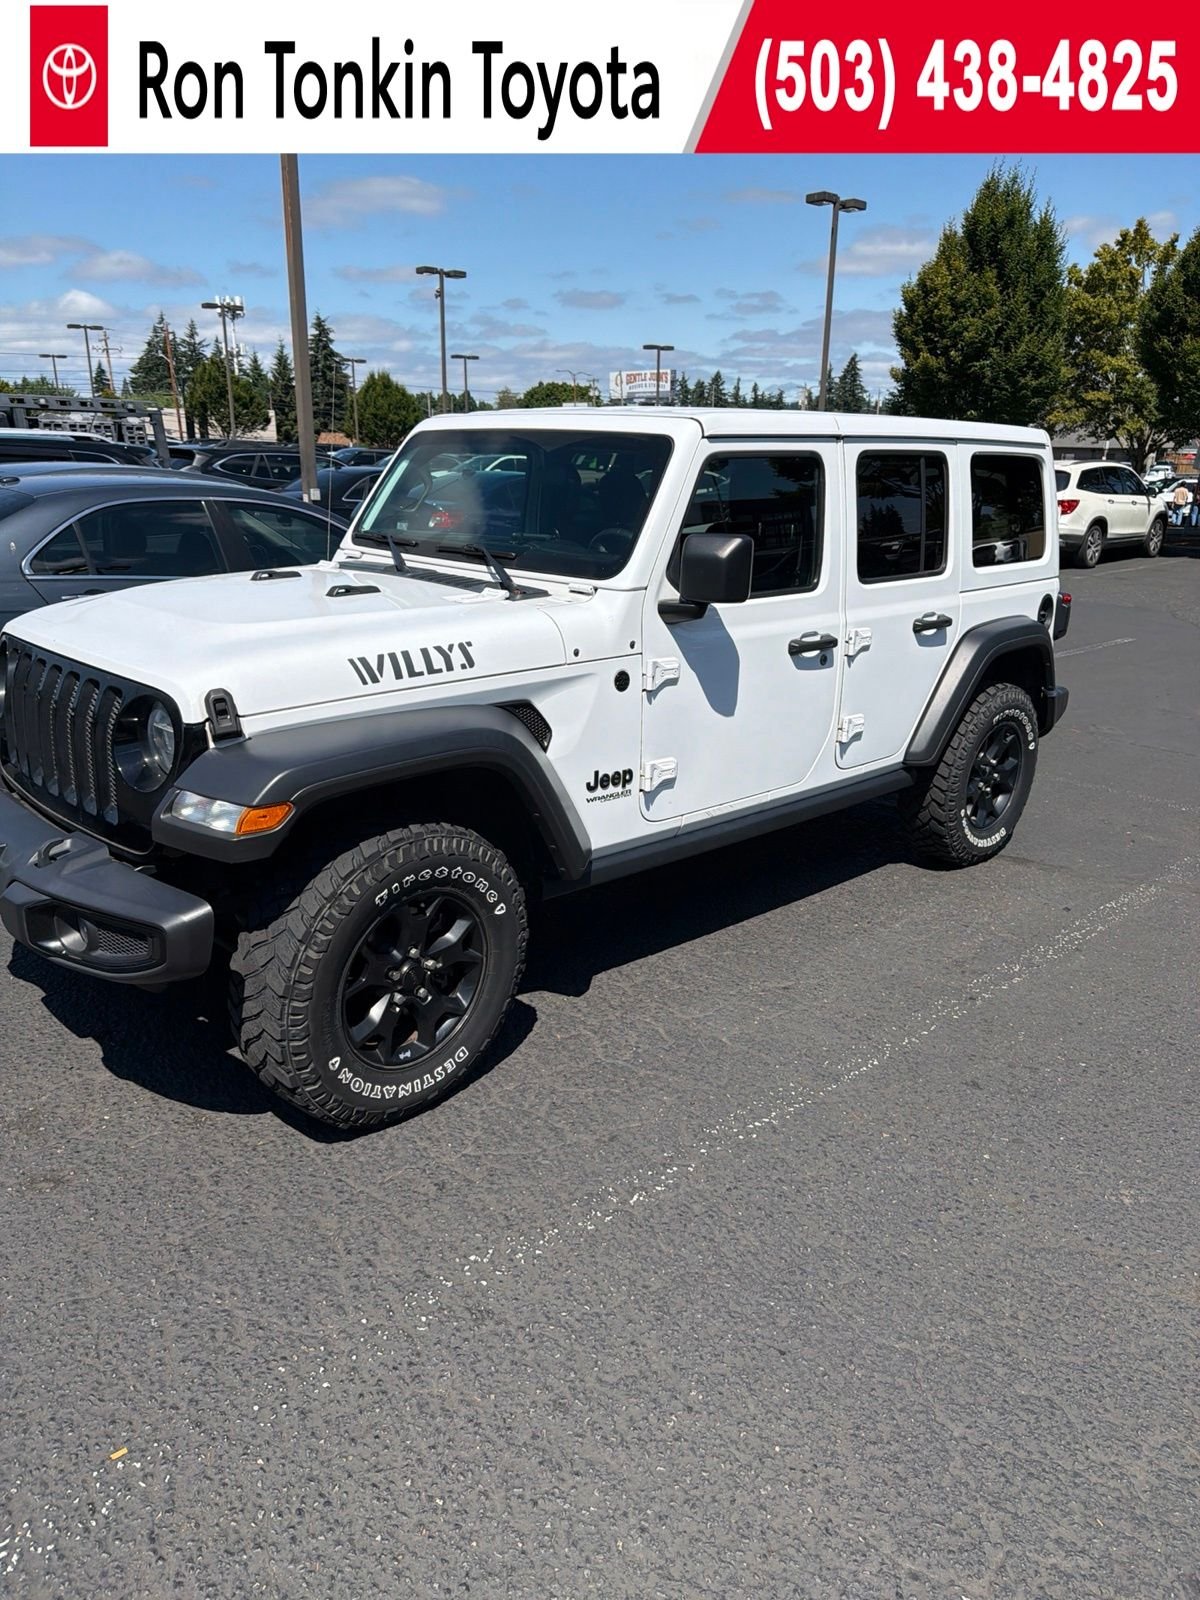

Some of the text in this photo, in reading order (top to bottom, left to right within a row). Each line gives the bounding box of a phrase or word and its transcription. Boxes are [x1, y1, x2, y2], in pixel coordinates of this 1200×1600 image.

[648, 372, 668, 384] JON'S
[347, 641, 476, 686] WILLYS
[586, 768, 633, 793] Jeep
[586, 789, 632, 803] WRANGLER
[375, 866, 499, 907] Firestone
[337, 1046, 469, 1099] DESTINATION
